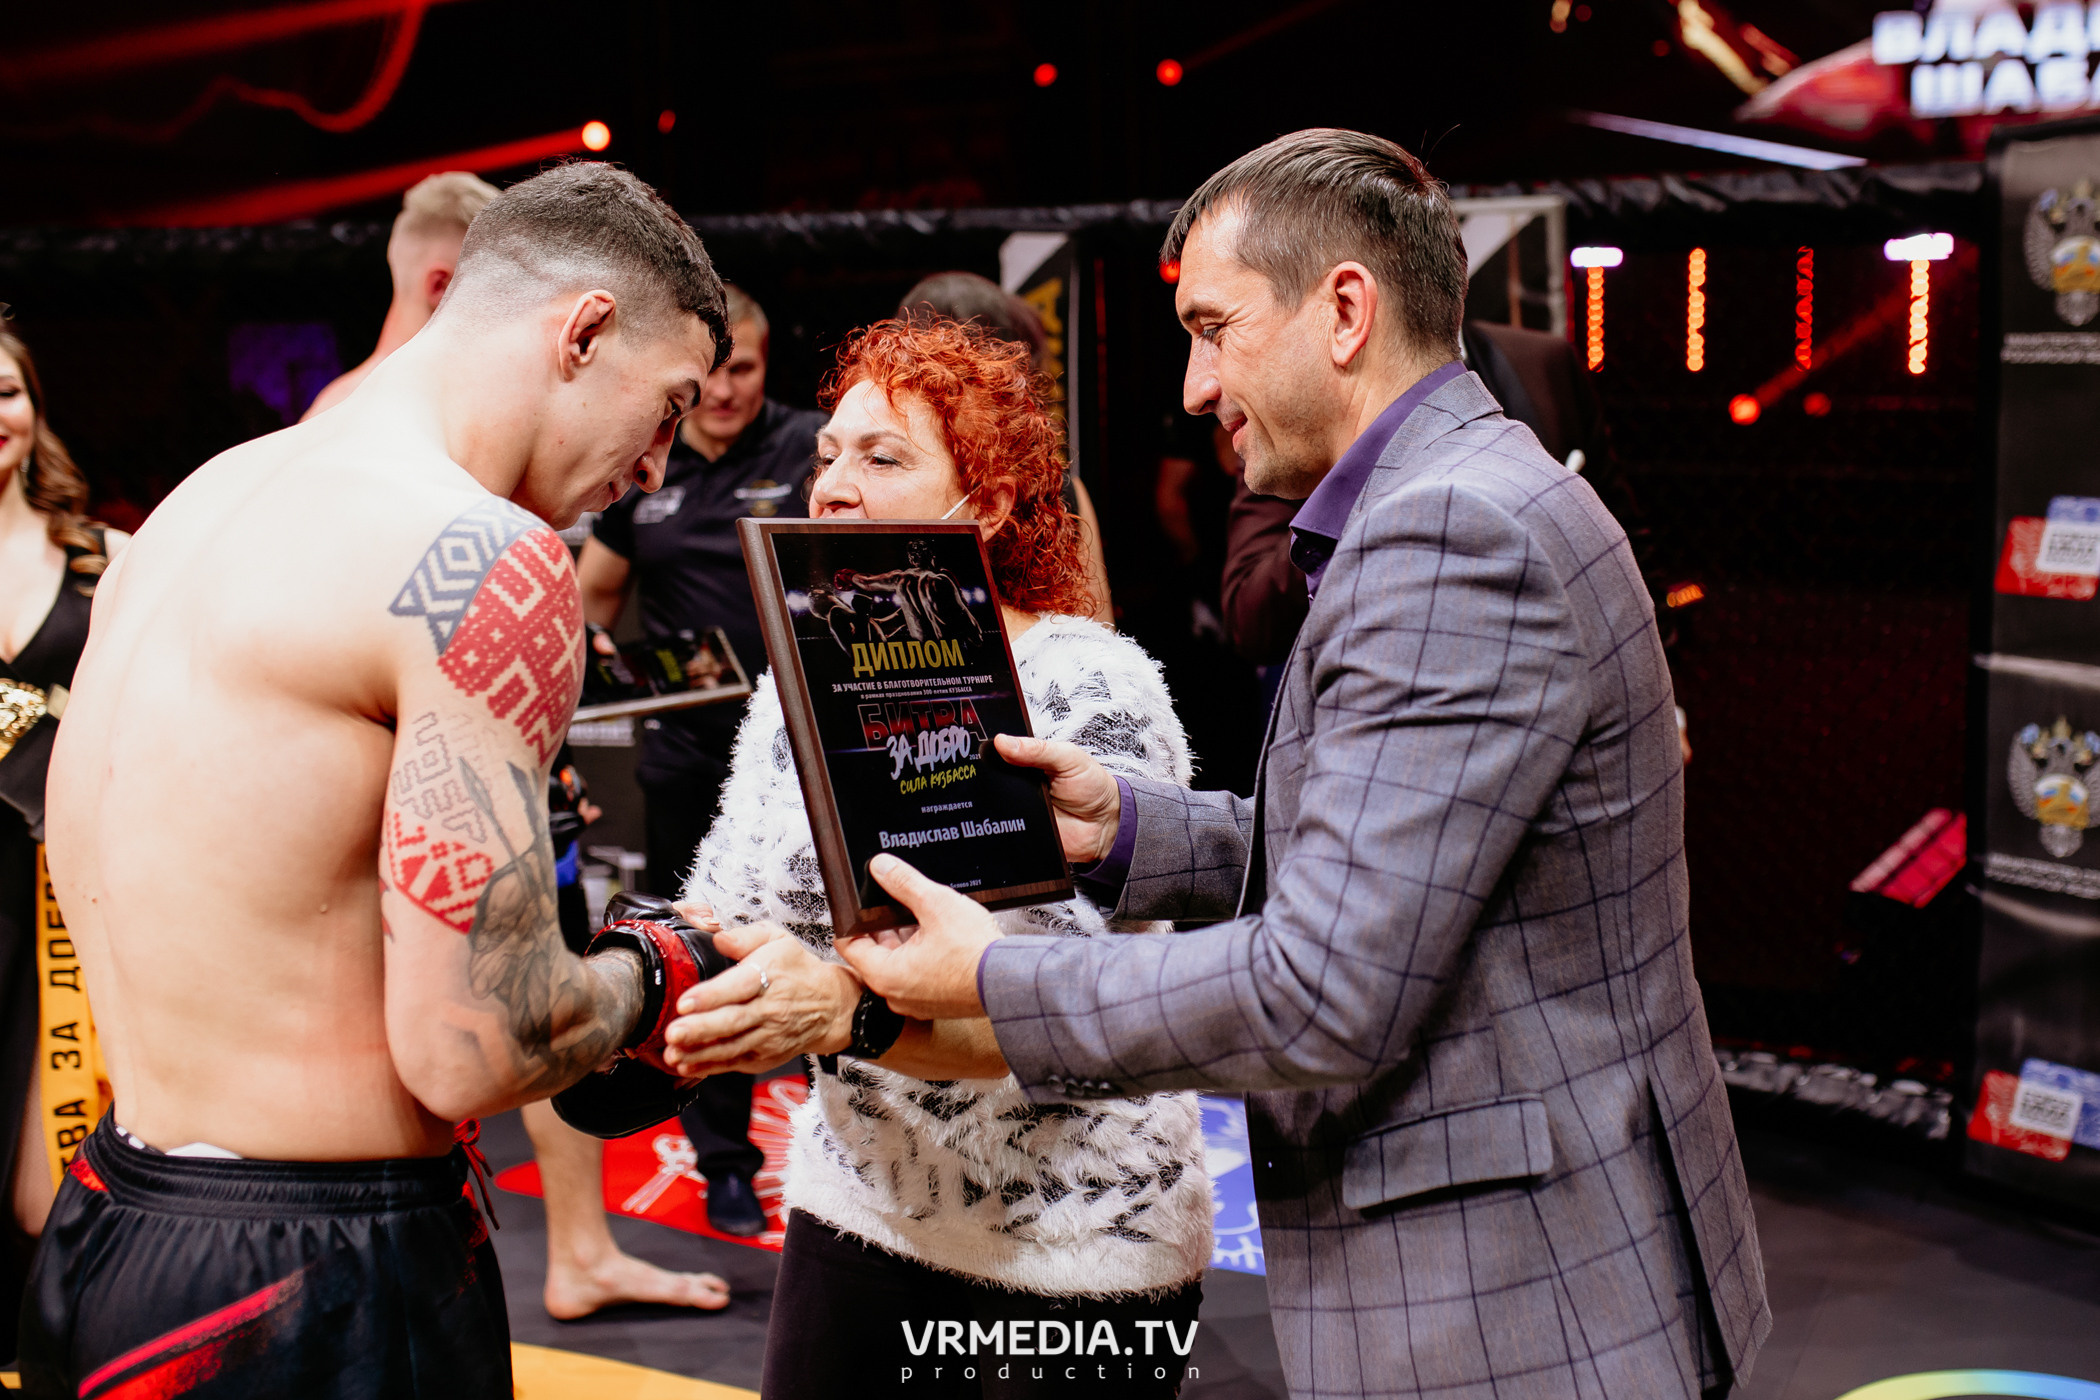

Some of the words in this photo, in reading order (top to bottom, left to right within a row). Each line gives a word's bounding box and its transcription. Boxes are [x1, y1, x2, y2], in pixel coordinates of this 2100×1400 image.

[1872, 3, 2100, 65] ВЛАД
[1911, 59, 2100, 119] ШАБ
[851, 639, 965, 678] ДИПЛОМ
[832, 684, 843, 693] ЗА
[843, 681, 876, 692] УЧАСТИЕ
[877, 680, 883, 690] В
[883, 676, 962, 690] БЛАГОТВОРИТЕЛЬНОМ
[962, 675, 993, 685] ТУРНИРЕ
[857, 698, 988, 751] БИТВА
[886, 734, 913, 780] ЗА
[914, 725, 971, 773] ДОБРО
[900, 776, 927, 795] СИЛА
[930, 764, 977, 789] КУЗБАССА
[921, 801, 973, 814] награждается
[879, 826, 960, 849] Владислав
[960, 818, 1026, 838] Шабалин
[51, 1021, 81, 1071] ЗА
